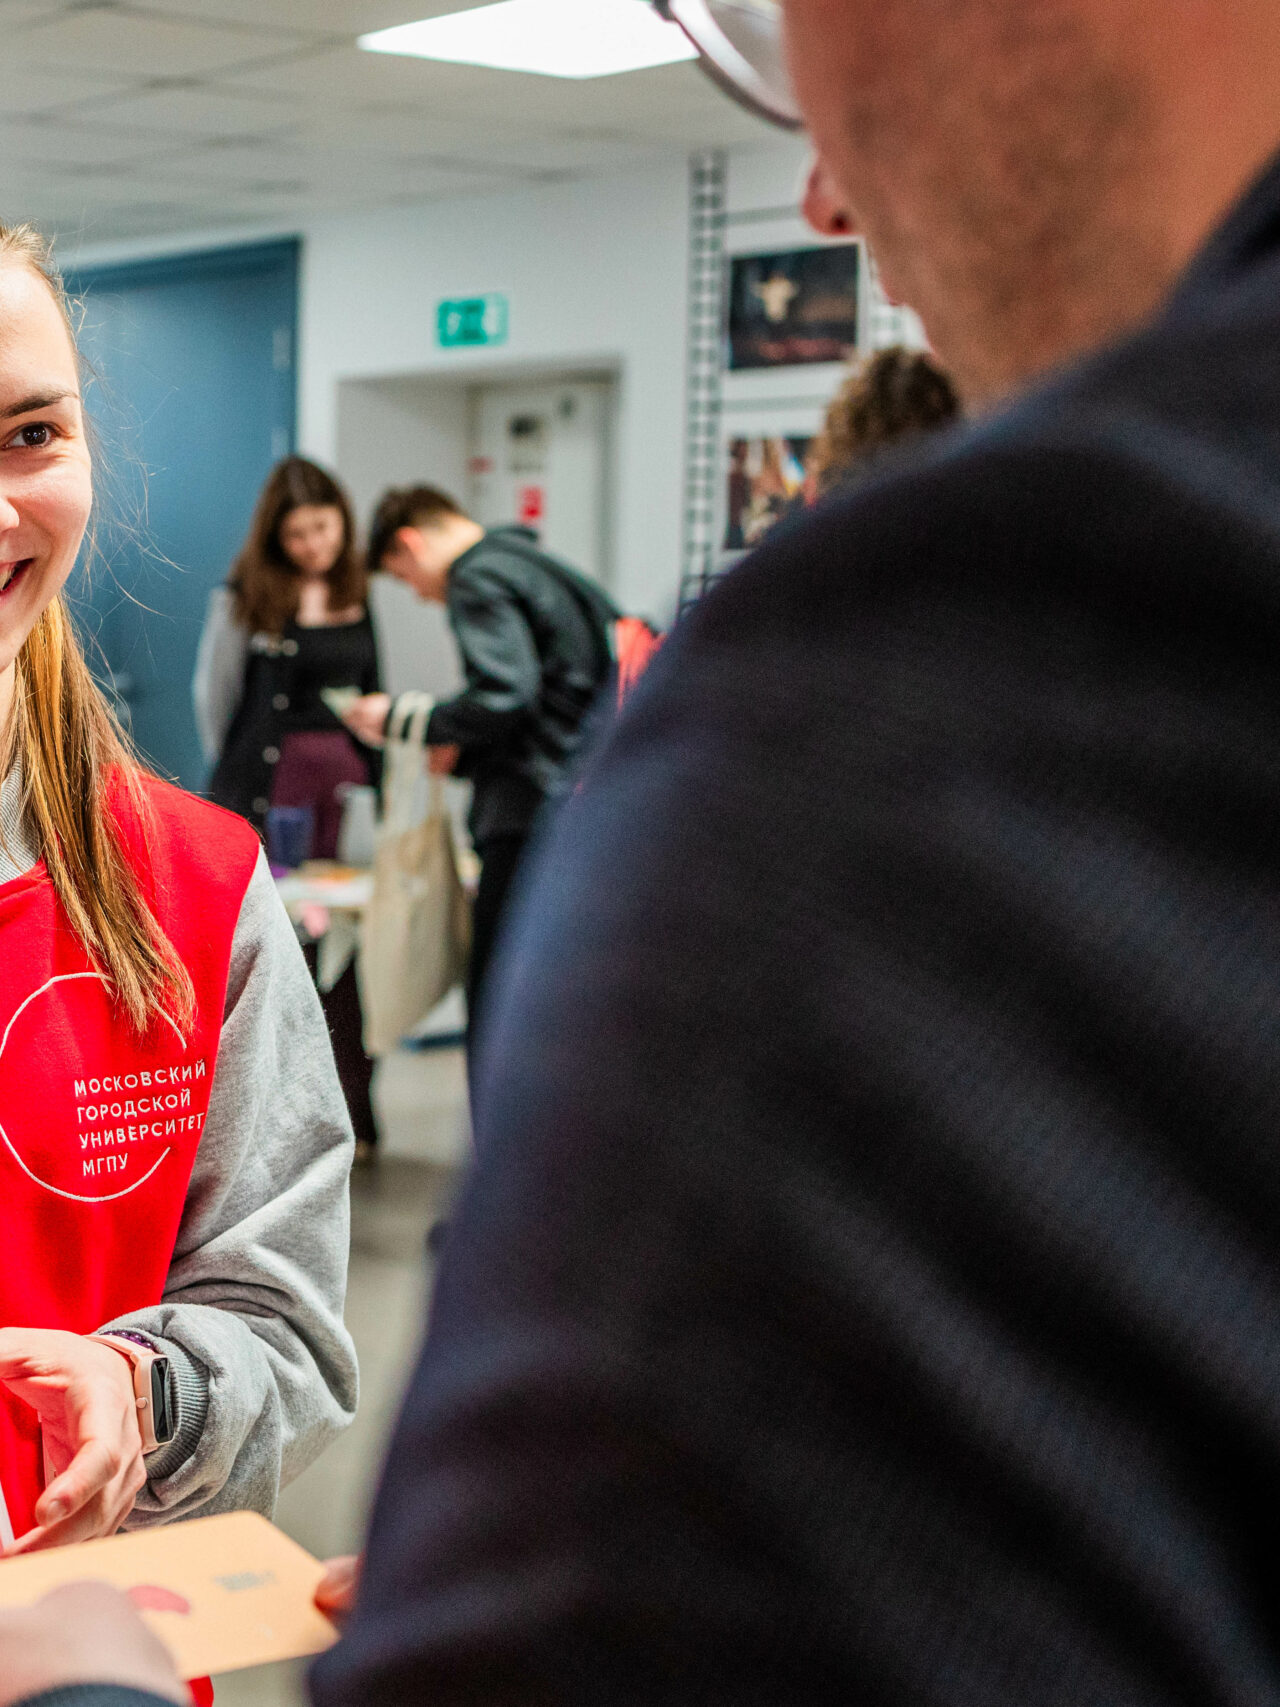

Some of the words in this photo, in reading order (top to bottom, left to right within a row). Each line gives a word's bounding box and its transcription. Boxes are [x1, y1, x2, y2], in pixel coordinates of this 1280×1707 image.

[74, 1059, 206, 1097] МОСКОВСКИЙ
[77, 1088, 191, 1123] ГОРОДСКОЙ
[79, 1112, 205, 1149] УНИВЕРСИТЕТ
[82, 1153, 128, 1176] МГПУ
